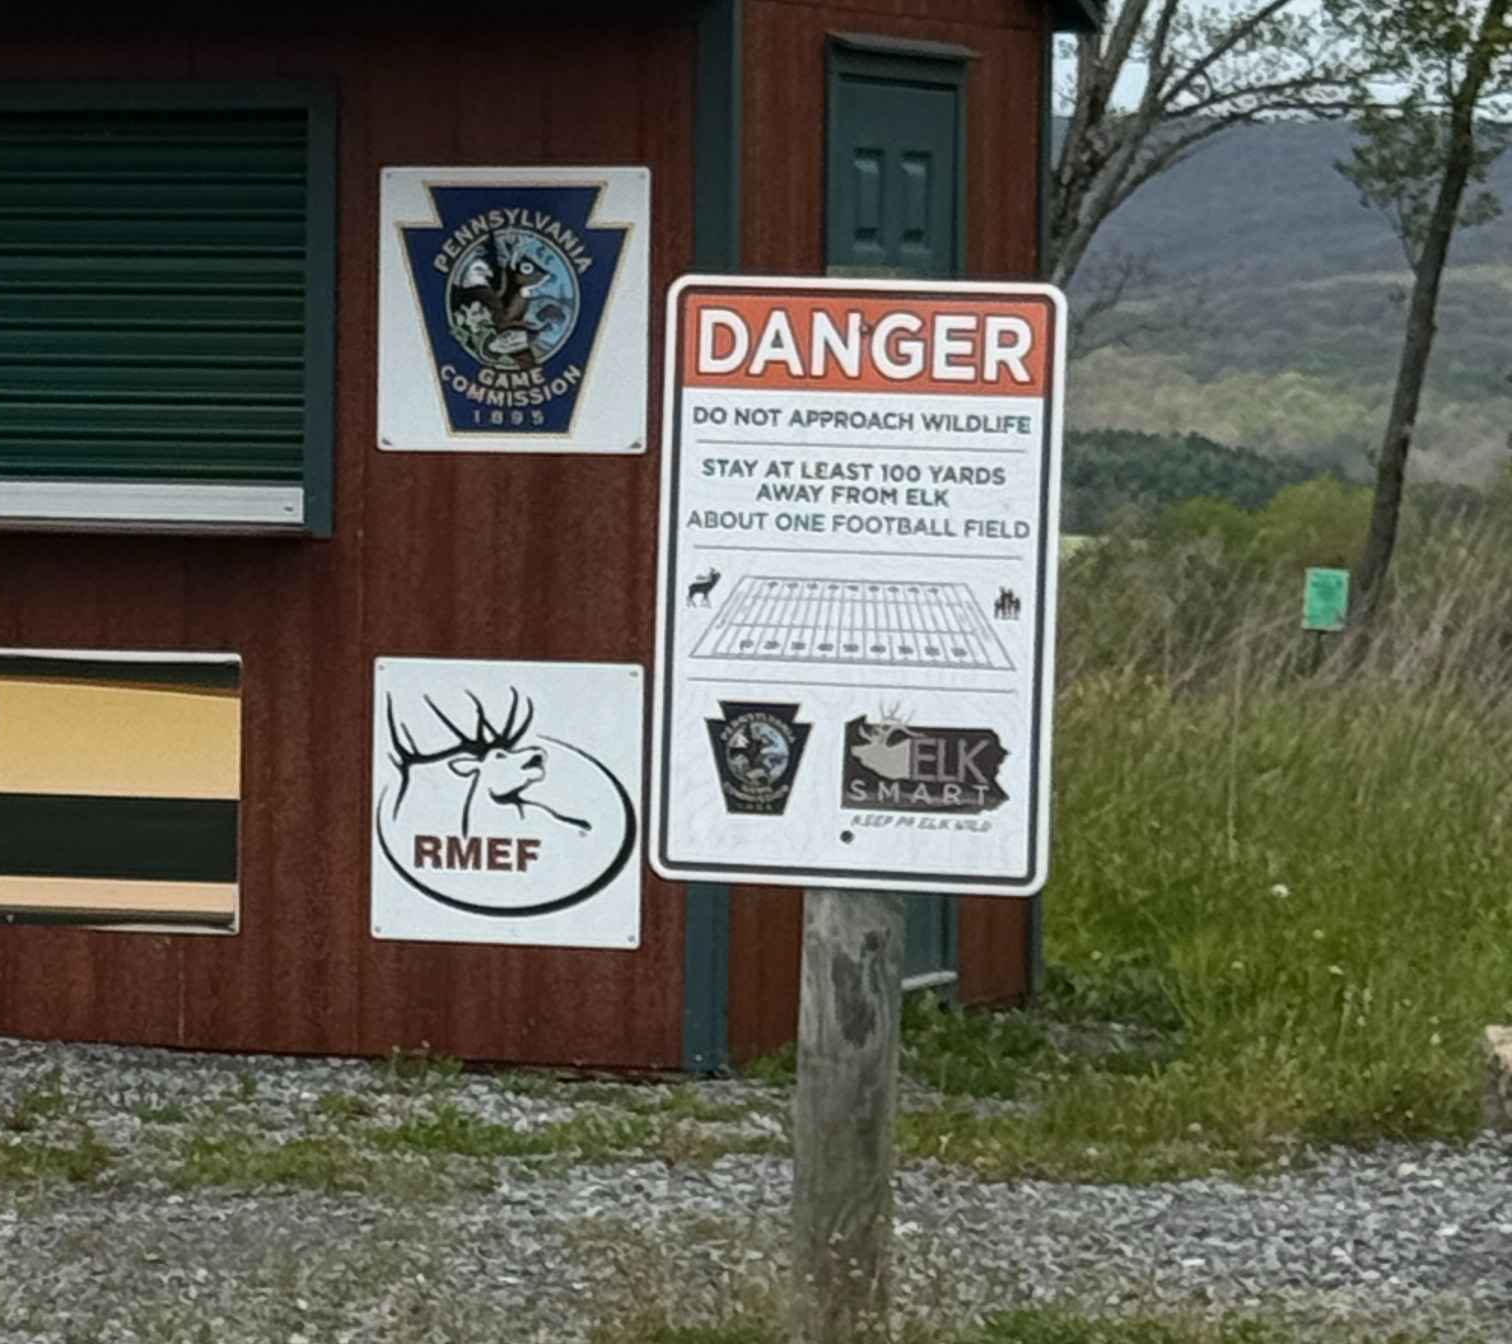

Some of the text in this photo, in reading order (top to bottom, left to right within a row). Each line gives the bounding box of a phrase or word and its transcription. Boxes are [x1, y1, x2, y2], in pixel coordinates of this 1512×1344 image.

[433, 208, 593, 274] PENNSYLVANIA
[695, 306, 1034, 383] DANGER
[440, 364, 581, 406] COMMISSION
[478, 369, 544, 388] GAME
[473, 411, 544, 425] 1895
[692, 406, 1031, 434] DO NOT APPROACH WILDLIFE
[701, 458, 1006, 485] STAY AT LEAST 100 YARDS
[755, 484, 950, 507] AWAY FROM ELK
[687, 511, 1031, 539] ABOUT ONE FOOTBALL FIELD
[911, 738, 988, 784] ELK
[847, 782, 990, 807] SMART
[414, 835, 541, 872] RMEF
